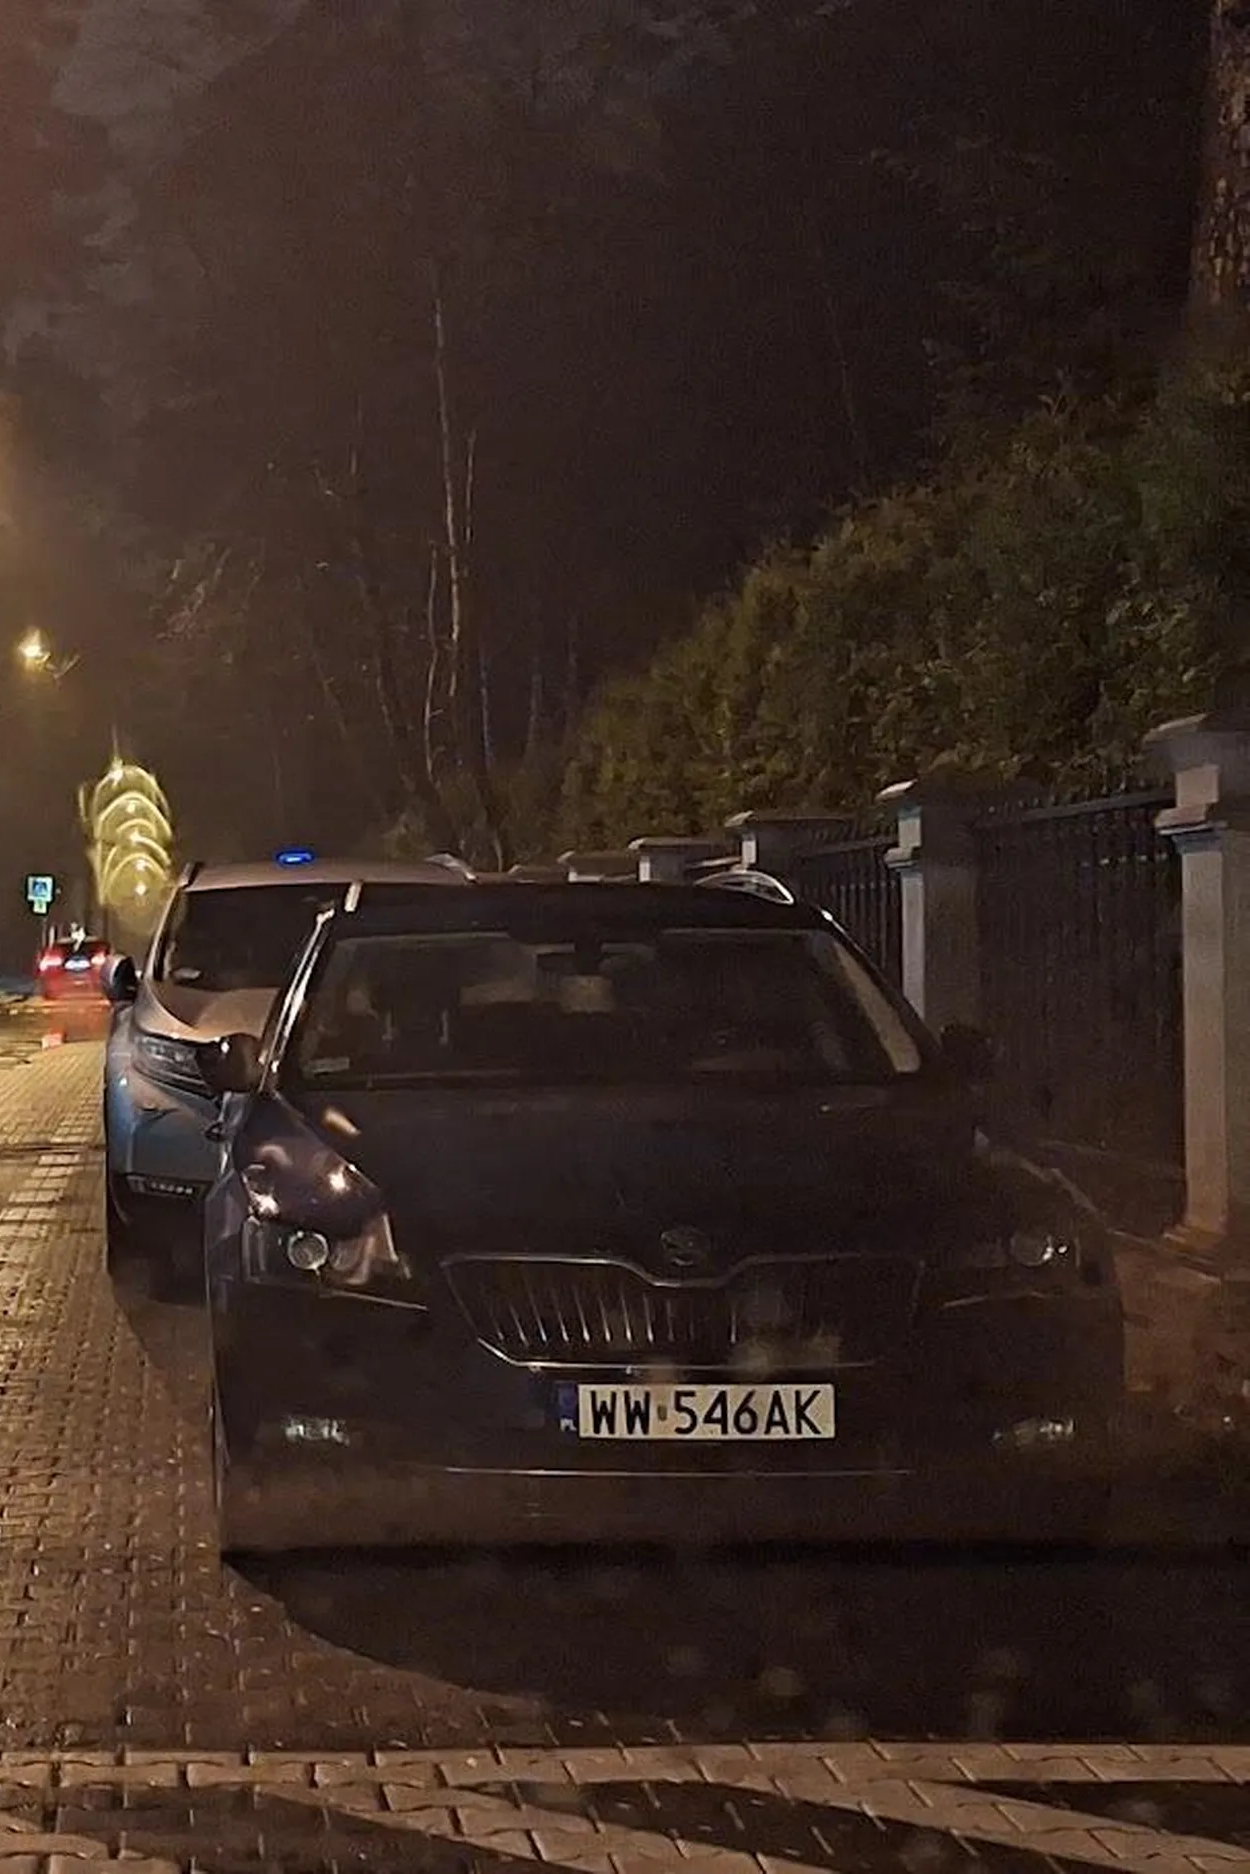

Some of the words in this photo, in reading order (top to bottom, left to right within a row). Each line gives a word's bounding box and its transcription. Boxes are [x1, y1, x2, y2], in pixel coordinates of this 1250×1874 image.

[560, 1418, 577, 1432] PL
[590, 1390, 651, 1435] WW
[673, 1389, 821, 1435] 546AK
